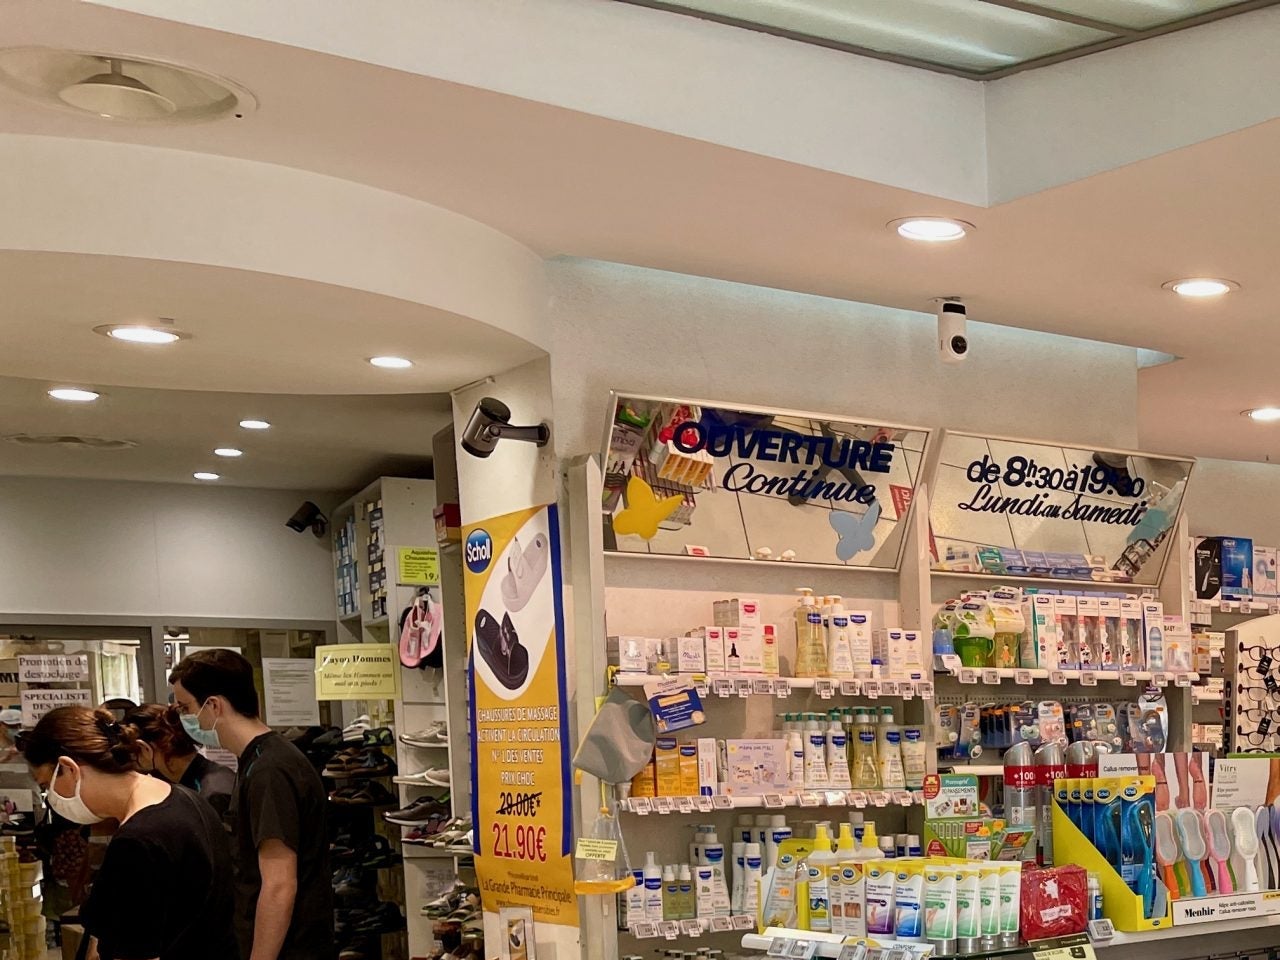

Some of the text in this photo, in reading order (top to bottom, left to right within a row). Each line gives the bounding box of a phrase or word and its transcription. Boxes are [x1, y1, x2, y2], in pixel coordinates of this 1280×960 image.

[672, 421, 895, 473] OUVERTURE
[966, 455, 1000, 483] de
[722, 463, 877, 504] Continue
[958, 484, 1049, 517] Lundi
[1062, 493, 1148, 526] Samedi
[465, 539, 493, 563] Scholl
[19, 657, 73, 667] Promotion
[24, 693, 89, 701] SPECIALISTE
[478, 706, 558, 722] CHAUSSURES DE MASSAGE
[477, 727, 561, 743] ACTIVENT LA CIRCULATION
[506, 749, 519, 763] DES
[520, 749, 544, 763] VENTES
[501, 771, 536, 786] PRIX CHOC
[492, 822, 548, 863] 21.90€
[1184, 906, 1216, 918] Menhir
